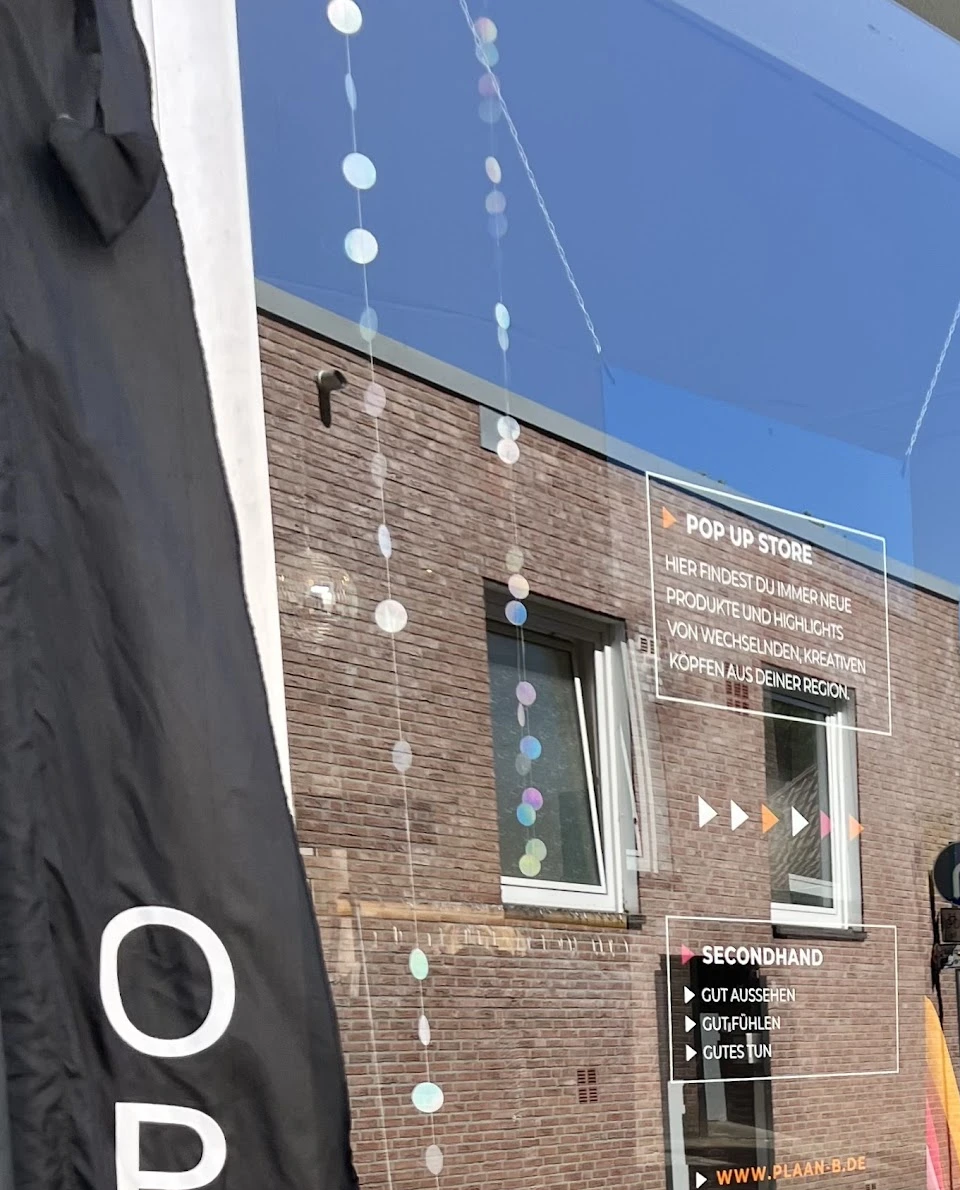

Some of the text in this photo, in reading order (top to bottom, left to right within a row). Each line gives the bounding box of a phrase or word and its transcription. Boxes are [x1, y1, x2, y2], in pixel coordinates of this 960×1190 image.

[686, 513, 813, 566] POP UP STORE
[665, 554, 853, 614] HIER FINDEST DU IMMER NEUE
[666, 587, 844, 641] PRODUKTE UND HIGHLIGHTS
[667, 619, 867, 675] VON WECHSELNDEN, KREATIVEN
[669, 650, 850, 700] KÖPFEN AUS DEINER REGION.
[701, 945, 823, 967] SECONDHAND
[701, 987, 797, 1003] GUT AUSSEHEN
[702, 1013, 781, 1032] GUT FÜHLEN
[703, 1043, 772, 1061] GUTES TUN
[716, 1155, 867, 1186] WWW.PLAAN-B.DE
